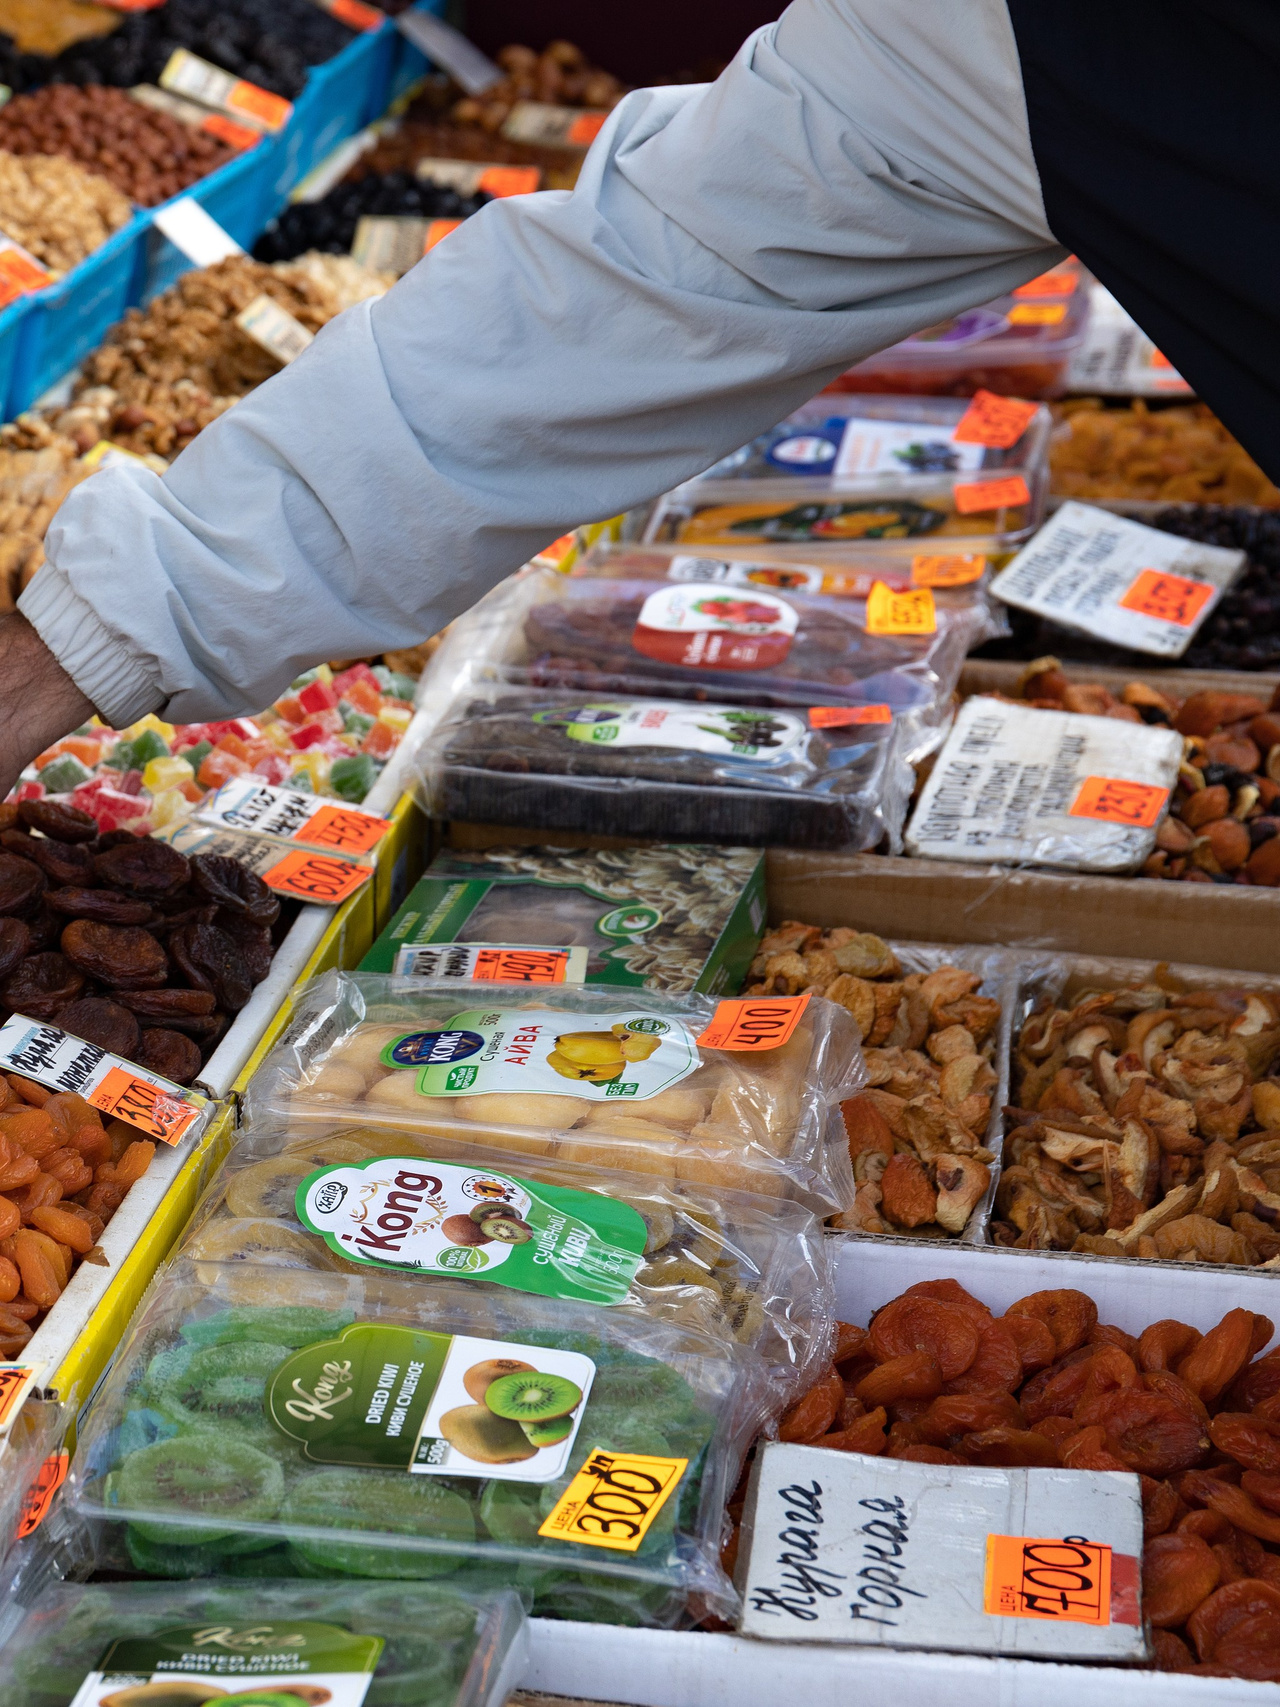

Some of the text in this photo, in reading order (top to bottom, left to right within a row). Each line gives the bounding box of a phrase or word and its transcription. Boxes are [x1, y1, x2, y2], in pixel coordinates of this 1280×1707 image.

[428, 1031, 464, 1062] KONG
[504, 1024, 543, 1066] АЙВА
[732, 1008, 792, 1045] 400
[285, 1360, 353, 1422] Kong
[365, 1363, 400, 1424] DRIED KIWI
[386, 1360, 425, 1437] КИВИ СУШЕНОЕ
[427, 1439, 450, 1465] 500g
[551, 1500, 581, 1530] ЦЕНА
[577, 1469, 663, 1539] 300
[749, 1480, 848, 1621] Курага
[1000, 1585, 1016, 1612] ЦЕНА
